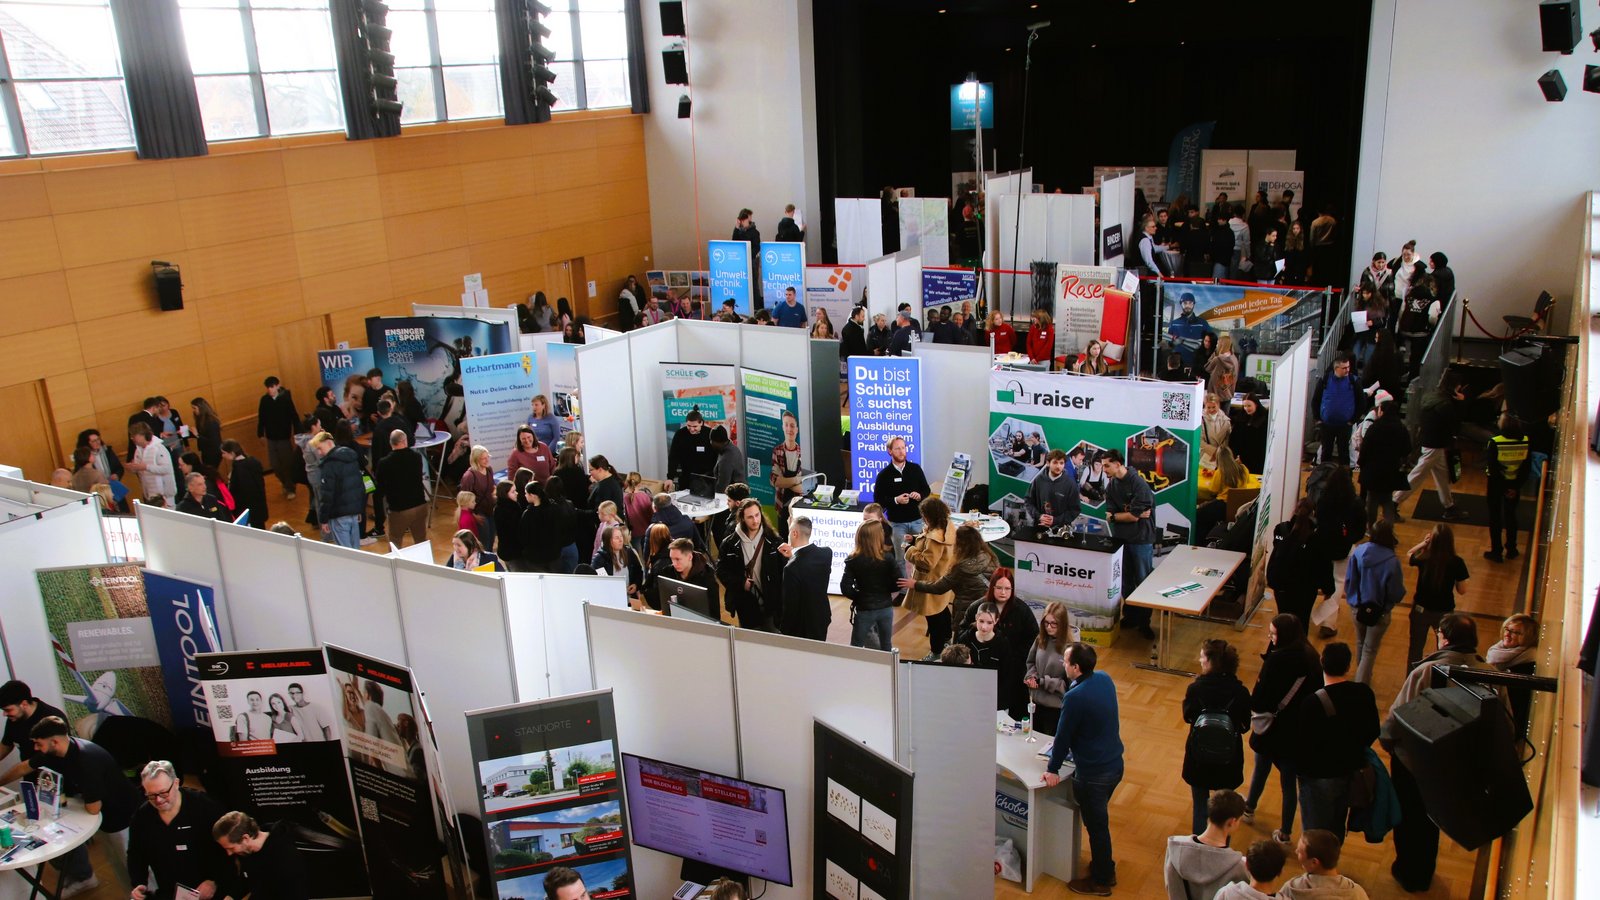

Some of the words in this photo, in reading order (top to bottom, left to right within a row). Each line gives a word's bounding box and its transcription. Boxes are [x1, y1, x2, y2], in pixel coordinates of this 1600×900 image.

[1268, 181, 1303, 190] DEHOGA
[710, 277, 743, 288] Technik.
[723, 287, 736, 297] Du.
[1213, 301, 1247, 315] Spannend
[384, 327, 425, 336] ENSINGER
[321, 354, 353, 369] WIR
[665, 368, 694, 377] SCHÜLE
[855, 366, 878, 381] Du
[883, 366, 910, 382] bist
[855, 382, 911, 397] Schüler
[856, 397, 865, 408] &
[868, 398, 912, 409] suchst
[1033, 390, 1094, 409] raiser
[671, 408, 719, 419] GEGSEN!
[857, 410, 882, 420] nach
[886, 410, 912, 421] einer
[857, 421, 913, 434] Ausbildung
[857, 432, 879, 441] oder
[858, 457, 889, 469] Dann
[858, 468, 873, 479] du
[812, 527, 830, 537] The
[832, 530, 856, 539] futur
[813, 538, 822, 547] of
[1047, 562, 1096, 580] raiser
[102, 575, 141, 585] FEINTOOL
[78, 626, 134, 638] RENEWABLES.
[171, 594, 214, 730] EINTOOL
[261, 661, 312, 669] HELUKABEL
[514, 720, 572, 737] STANDORTE
[245, 766, 291, 775] Ausbildung
[653, 780, 672, 789] BILDEN
[672, 783, 683, 792] AUS
[703, 785, 714, 793] WIR
[714, 787, 736, 798] STELLEN
